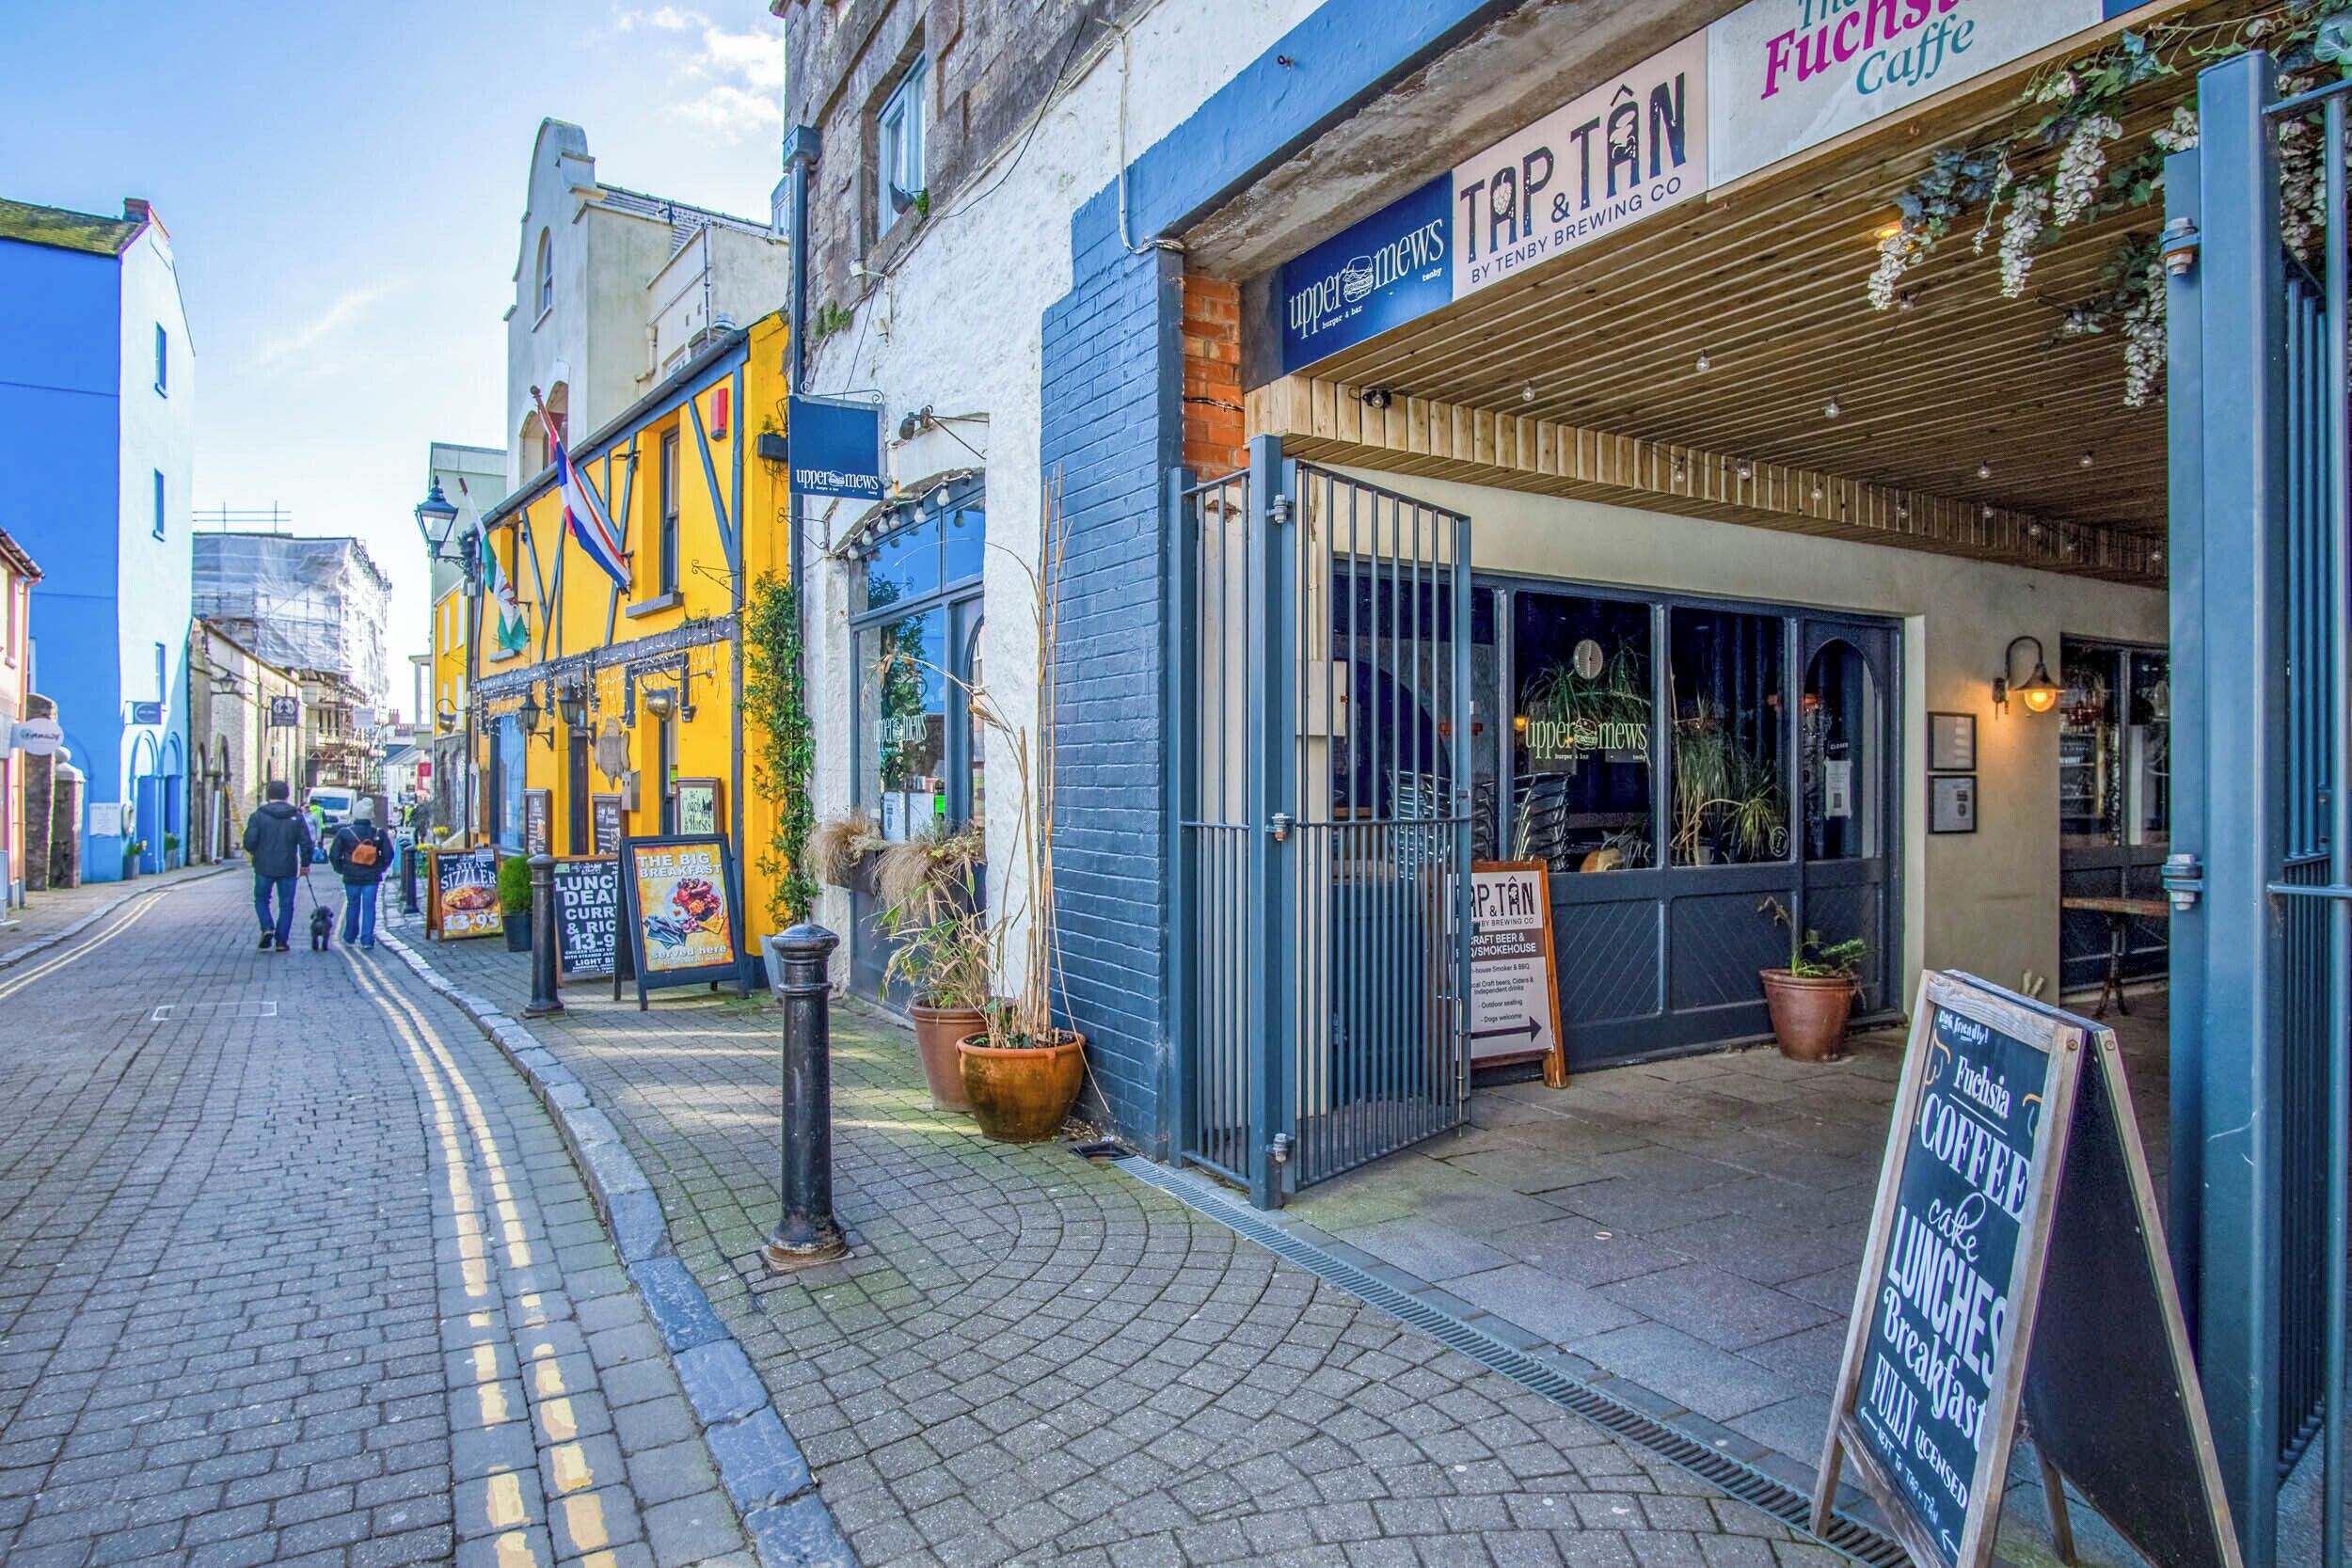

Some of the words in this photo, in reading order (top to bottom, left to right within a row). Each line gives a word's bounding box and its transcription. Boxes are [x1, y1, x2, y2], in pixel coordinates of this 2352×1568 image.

[1761, 0, 1958, 100] Fuchs
[1856, 13, 1976, 95] Caffe
[1460, 146, 1554, 264] TAP
[1550, 192, 1571, 224] &
[1570, 71, 1687, 212] TÂN
[1471, 263, 1491, 284] BY
[1496, 236, 1549, 273] TENBY
[1554, 194, 1643, 247] BREWING
[1651, 177, 1682, 203] CO
[1289, 267, 1347, 340] upper
[1373, 218, 1444, 291] mews
[1422, 267, 1442, 282] tenby
[1322, 313, 1344, 329] burger
[1350, 305, 1363, 316] bar
[796, 468, 831, 489] upper
[845, 473, 879, 490] mews
[1525, 720, 1576, 760] upper
[1598, 721, 1647, 751] mews
[637, 855, 674, 868] THE
[679, 853, 710, 866] BIG
[640, 863, 723, 879] BREAKFAST
[440, 868, 498, 890] SIZZLER
[564, 906, 616, 921] CURR
[1489, 905, 1498, 917] &
[1491, 917, 1523, 927] BREWING
[566, 922, 580, 935] &
[586, 920, 616, 933] RIC
[1496, 932, 1518, 942] BEER
[1518, 932, 1525, 942] &
[569, 932, 615, 951] 13-9
[699, 943, 727, 956] here
[575, 958, 603, 966] LIGHT
[1482, 979, 1495, 988] Craft
[1481, 1001, 1503, 1009] Outdoor
[1503, 998, 1523, 1007] seating
[1499, 1013, 1522, 1022] welcome
[1953, 1054, 2011, 1119] Fuchsia
[1921, 1093, 2031, 1224] COFFEE
[1929, 1192, 1987, 1262] cake
[1887, 1205, 2008, 1391] LUNCHES
[1883, 1285, 1987, 1453] Breakfast
[1869, 1352, 1919, 1451] FULLY
[1914, 1423, 1970, 1511] LICENSED
